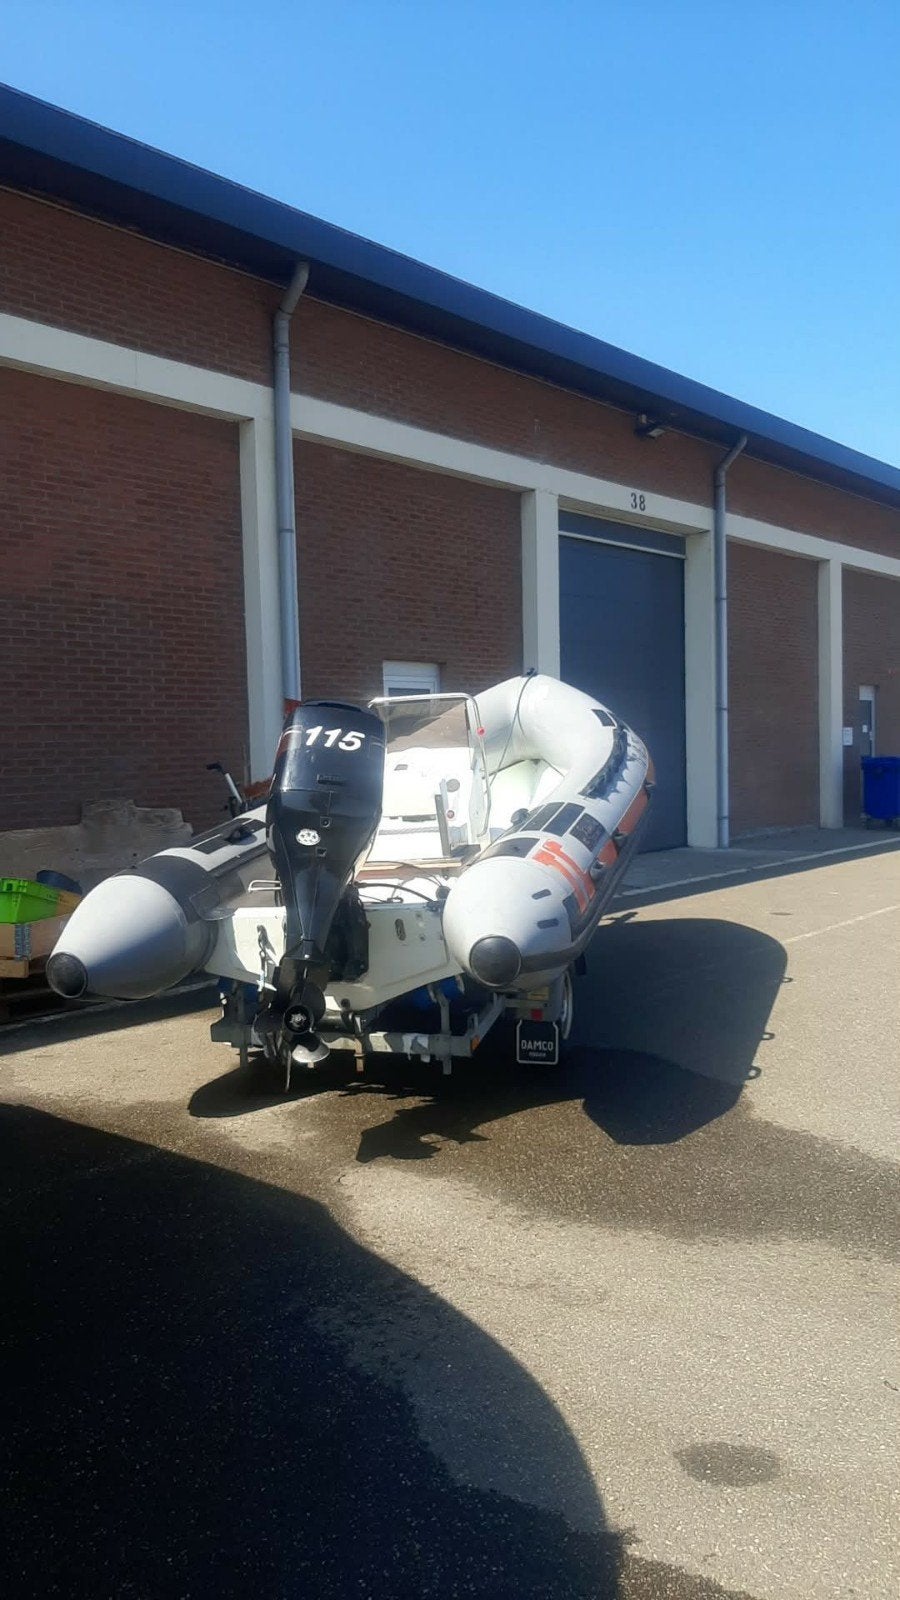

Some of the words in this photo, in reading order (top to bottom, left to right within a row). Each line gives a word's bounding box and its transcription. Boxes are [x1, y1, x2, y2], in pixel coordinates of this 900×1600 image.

[630, 492, 646, 512] 38
[305, 725, 366, 751] 115
[521, 1039, 554, 1051] DAMCO
